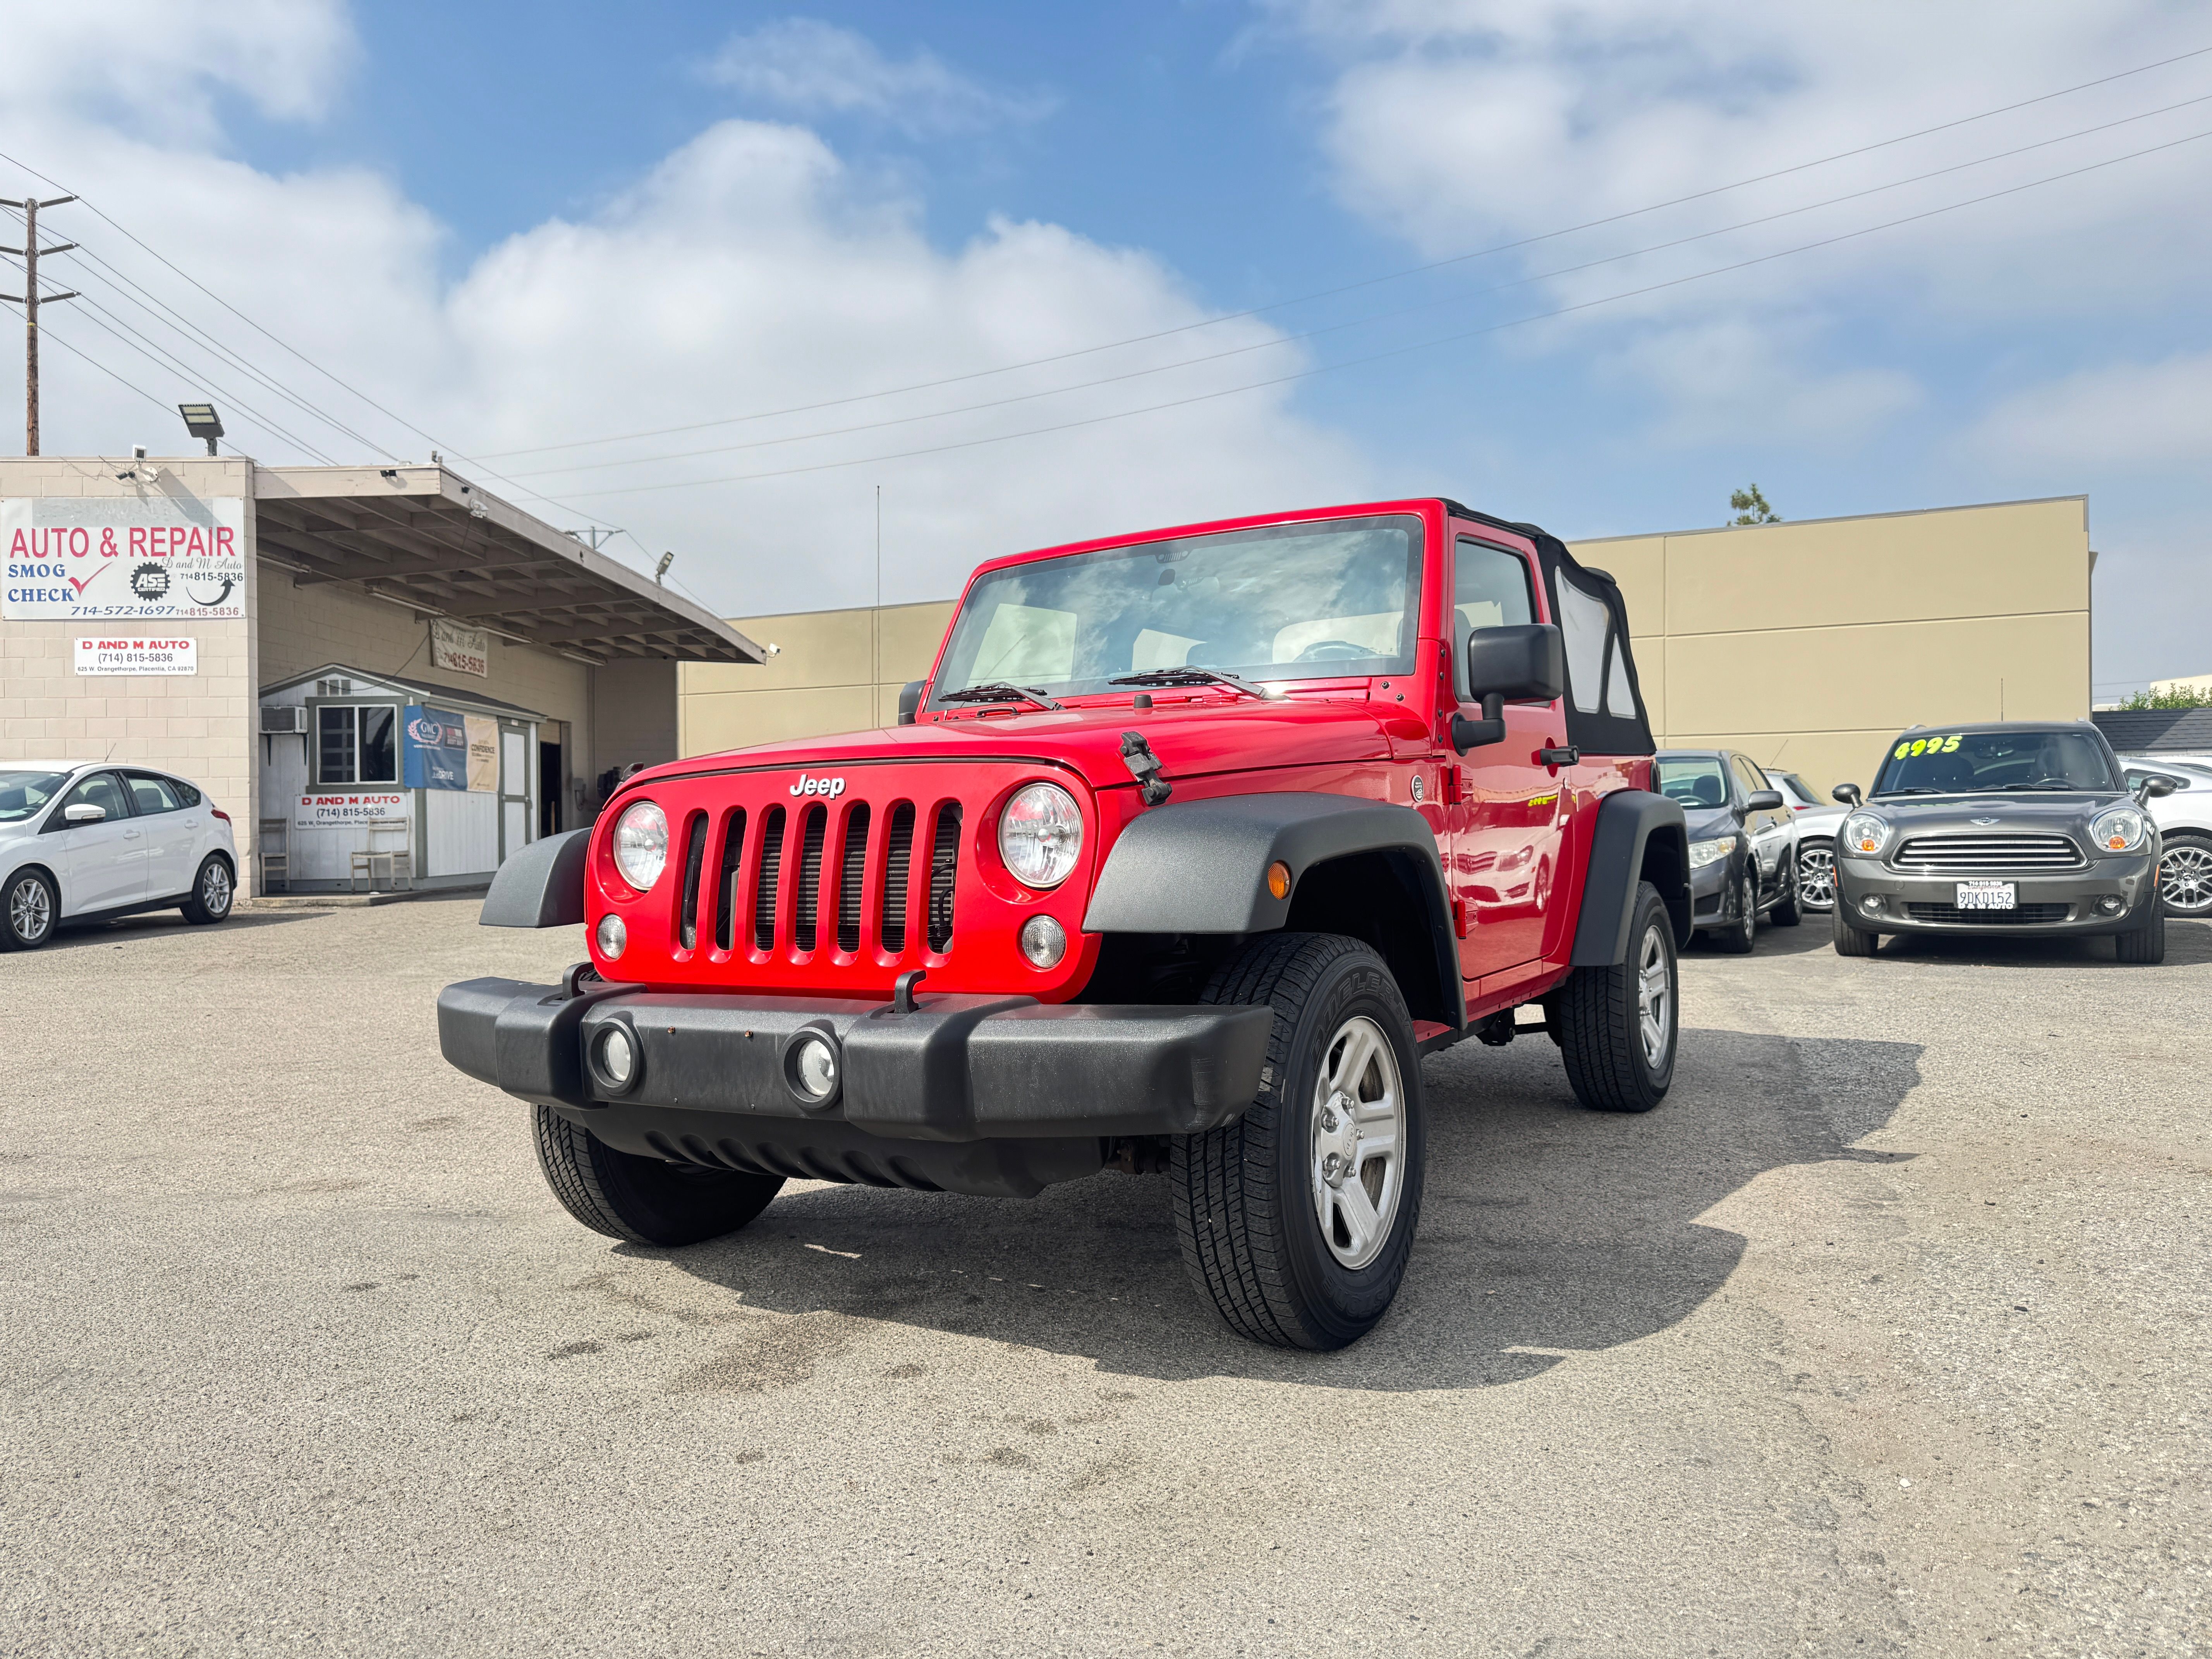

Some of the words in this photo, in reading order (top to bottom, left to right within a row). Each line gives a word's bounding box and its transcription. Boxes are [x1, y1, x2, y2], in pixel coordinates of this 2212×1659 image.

[10, 527, 89, 558] AUTO
[100, 527, 118, 558] &
[129, 527, 236, 557] REPAIR
[176, 558, 194, 568] and
[196, 557, 211, 569] M
[215, 558, 243, 569] Auto
[8, 564, 65, 577] SMOG
[136, 573, 166, 587] ASE
[8, 588, 74, 602] CHECK
[71, 606, 175, 615] 714-572-1697
[82, 641, 93, 649] D
[98, 641, 128, 649] AND
[133, 641, 144, 649] M
[149, 641, 189, 649] AUTO
[98, 653, 123, 664] (714)
[127, 653, 173, 662] 815-5836
[471, 744, 495, 754] CONFIDENCE
[1894, 735, 1963, 760] 4995
[789, 774, 847, 800] Jeep
[302, 797, 311, 805] D
[316, 797, 344, 805] AND
[363, 796, 400, 804] AUTO
[317, 808, 340, 818] (714)
[343, 807, 385, 816] 815-5836
[1960, 892, 2012, 904] 9DKD152
